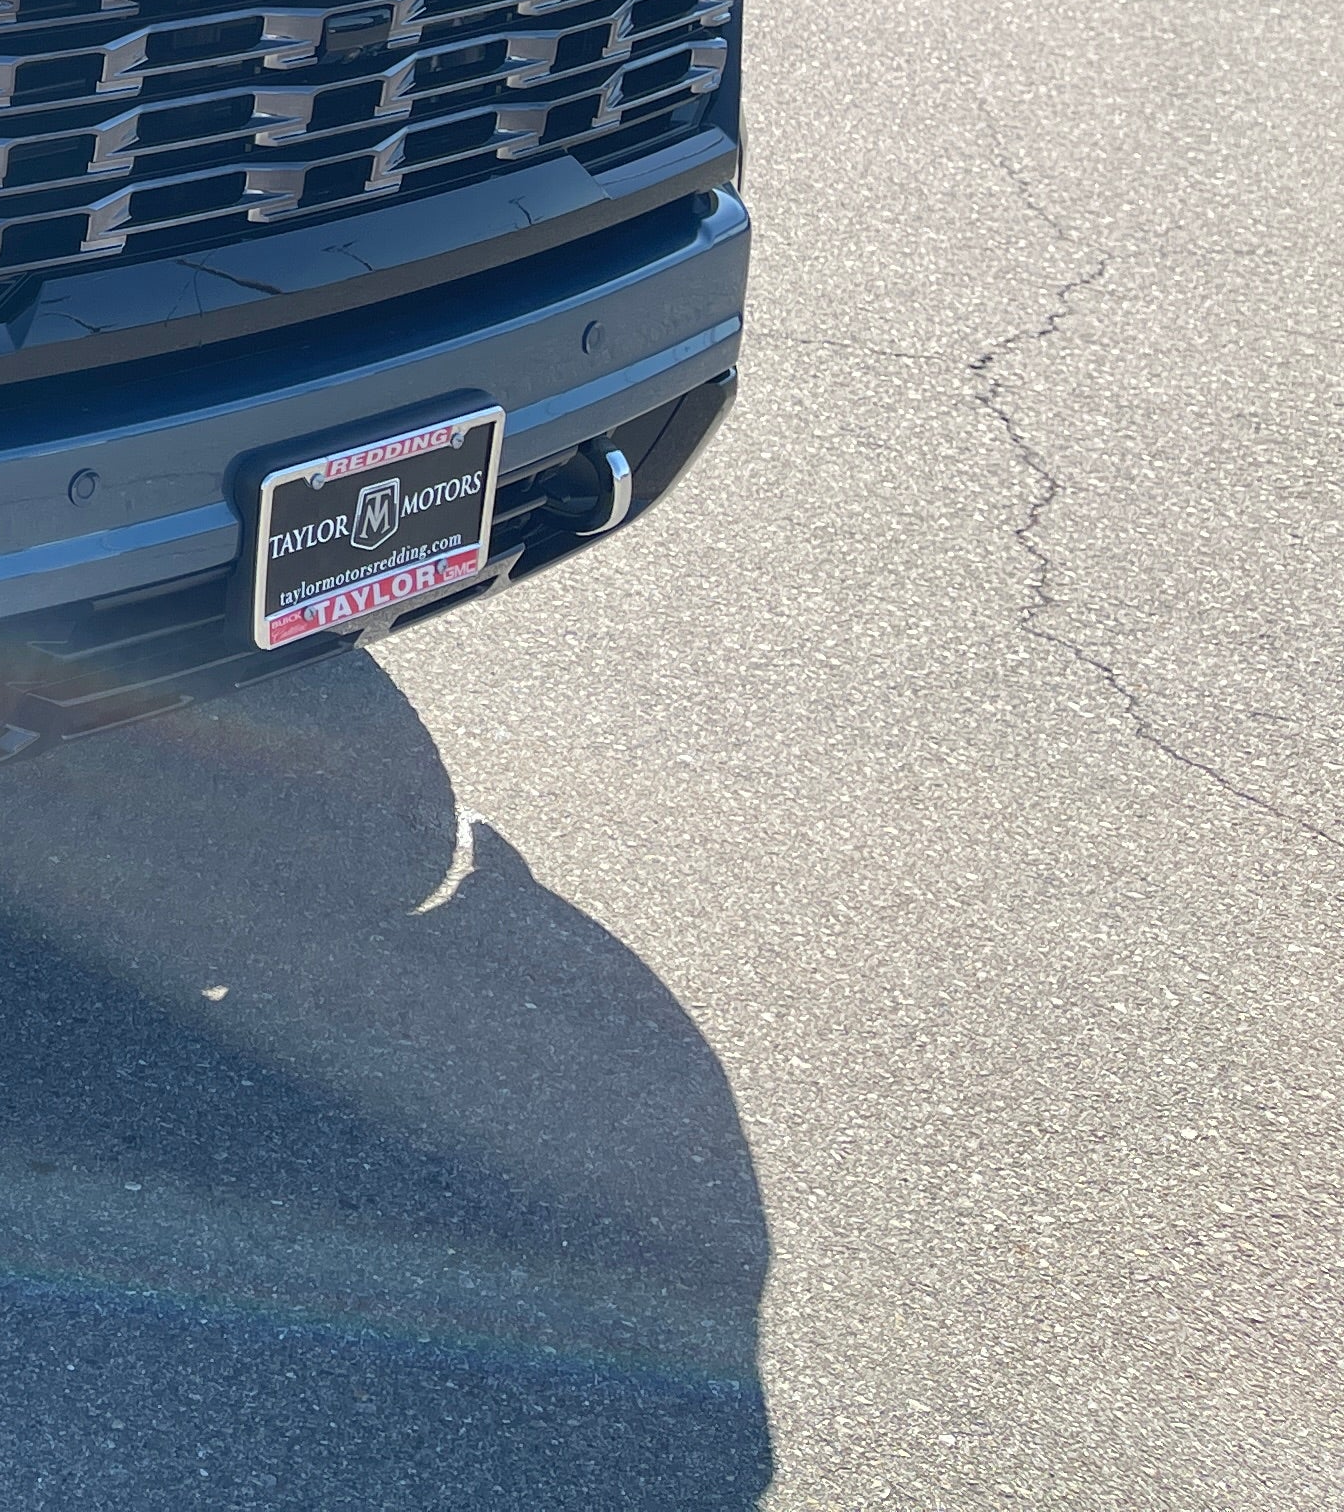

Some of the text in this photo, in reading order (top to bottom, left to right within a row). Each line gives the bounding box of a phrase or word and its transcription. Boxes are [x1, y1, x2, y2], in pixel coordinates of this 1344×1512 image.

[329, 428, 449, 476] REDDING
[269, 470, 483, 559] TAYLOR MOTORS
[279, 533, 462, 606] taylormotorsredding.com
[314, 565, 436, 626] TAYLOR
[443, 559, 477, 581] GMC
